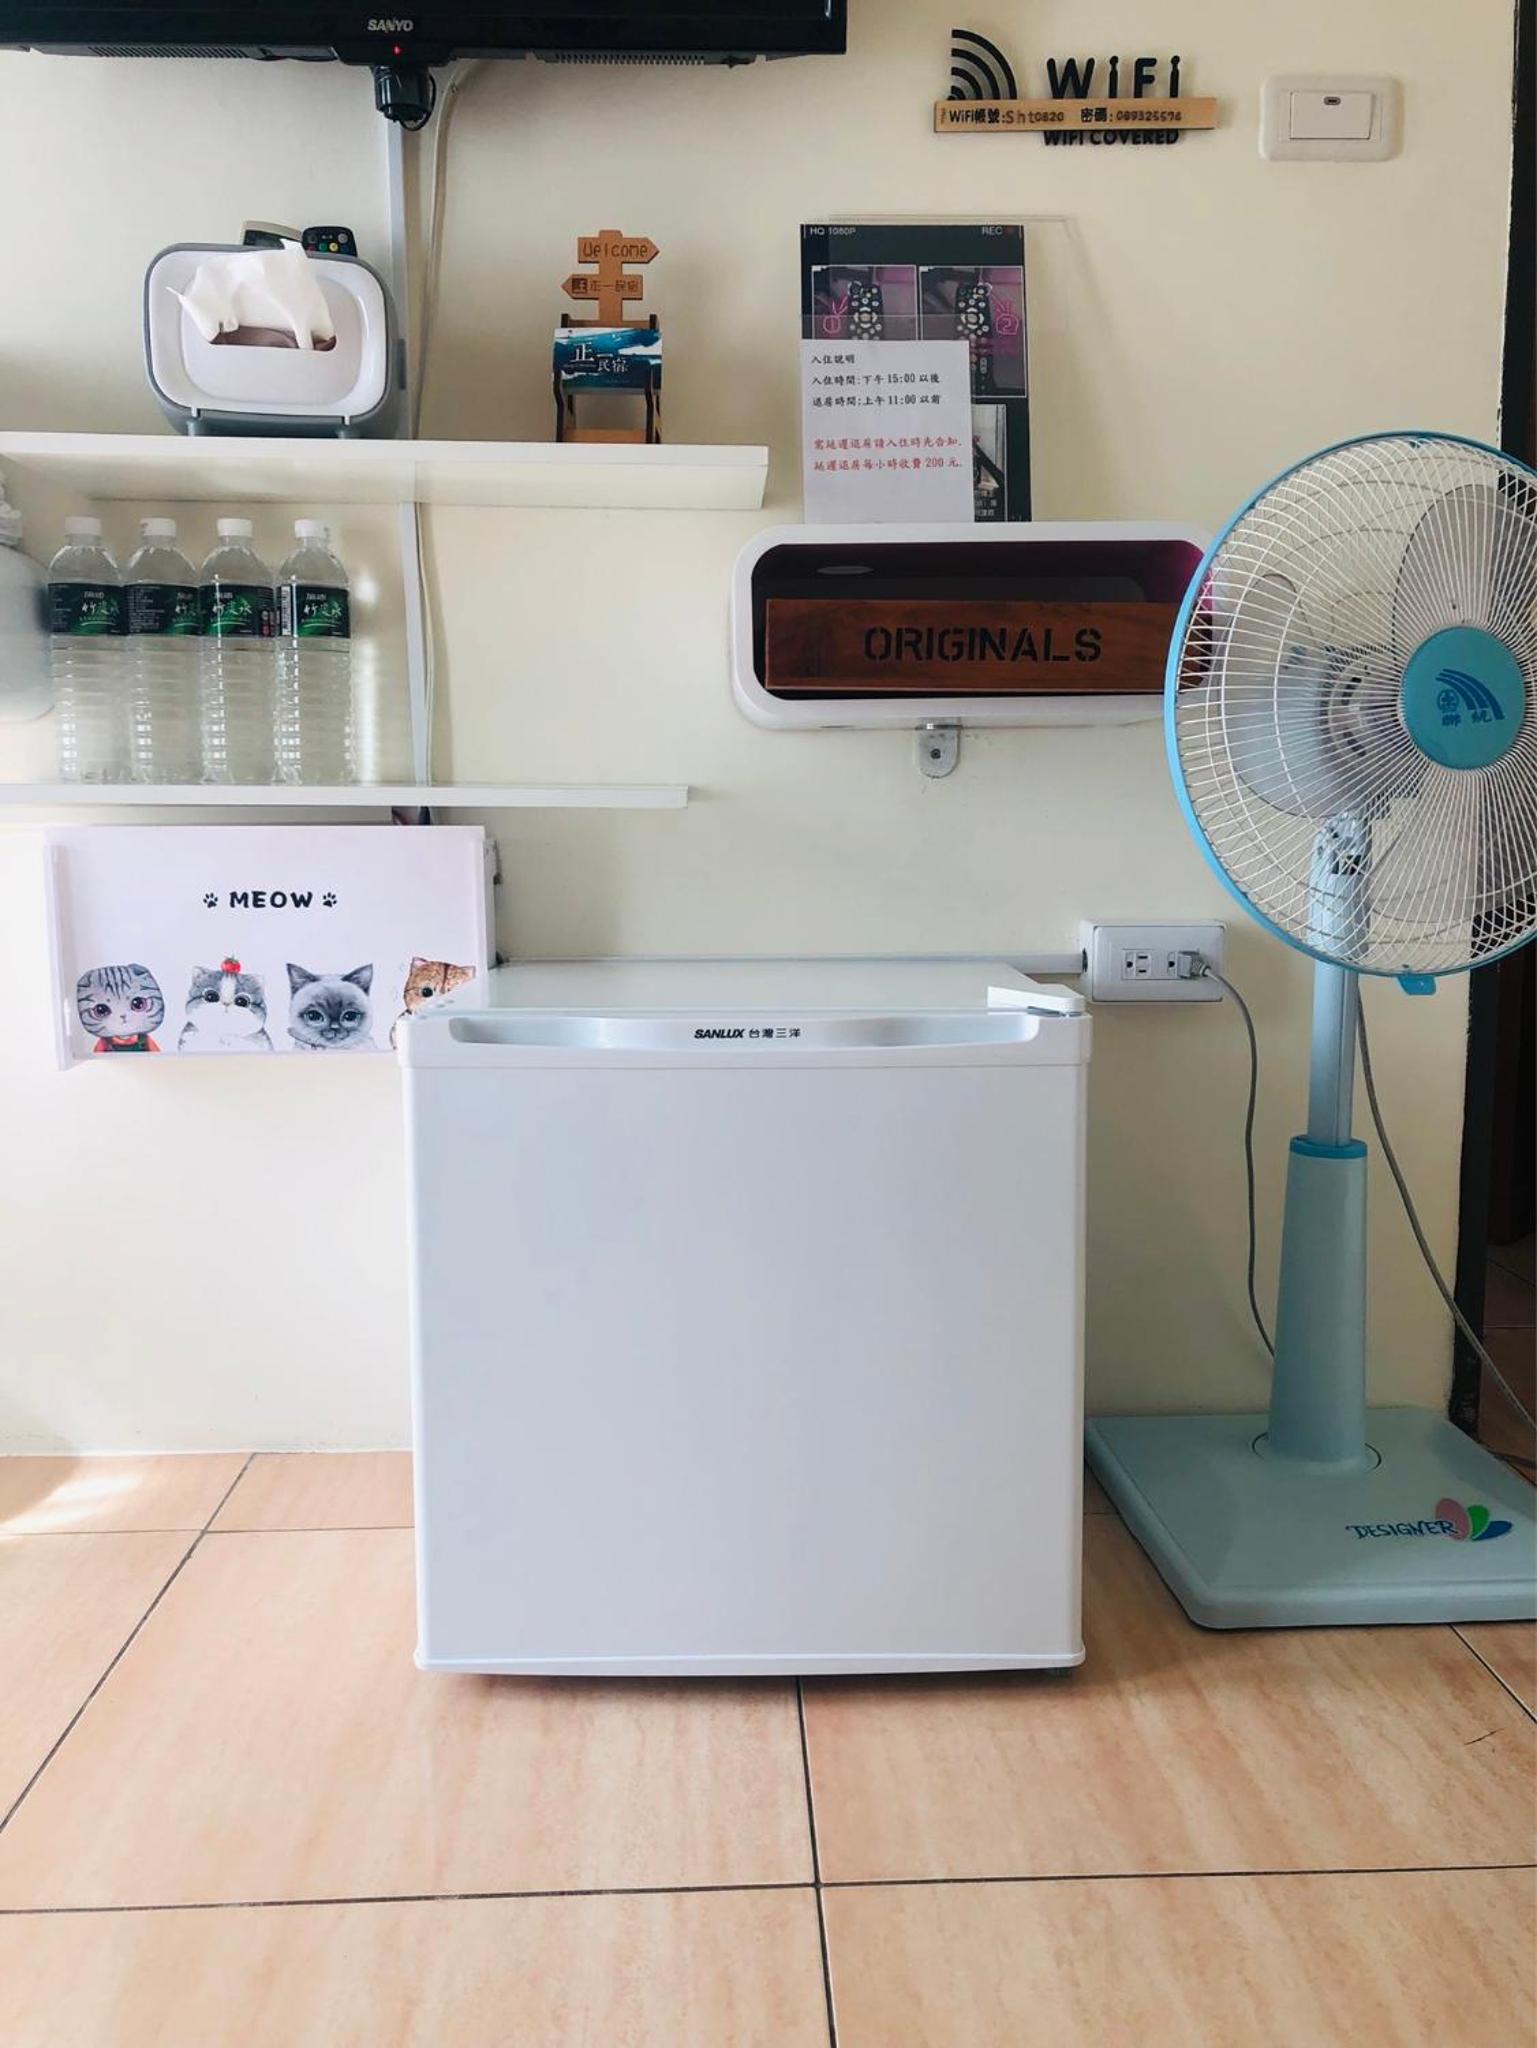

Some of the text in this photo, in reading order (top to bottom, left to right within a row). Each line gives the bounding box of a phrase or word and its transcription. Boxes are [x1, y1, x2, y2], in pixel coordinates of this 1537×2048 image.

[367, 18, 414, 32] SANYO
[1089, 128, 1180, 146] COVERED
[810, 227, 826, 236] HQ
[981, 226, 1003, 236] REC
[582, 242, 648, 258] Welcome
[811, 354, 855, 365] 入住說明
[863, 626, 1102, 663] ORIGINALS
[229, 890, 314, 909] MEOW
[694, 1028, 801, 1039] SANLUX 台灣三洋
[1345, 1519, 1459, 1540] DESIGNER
